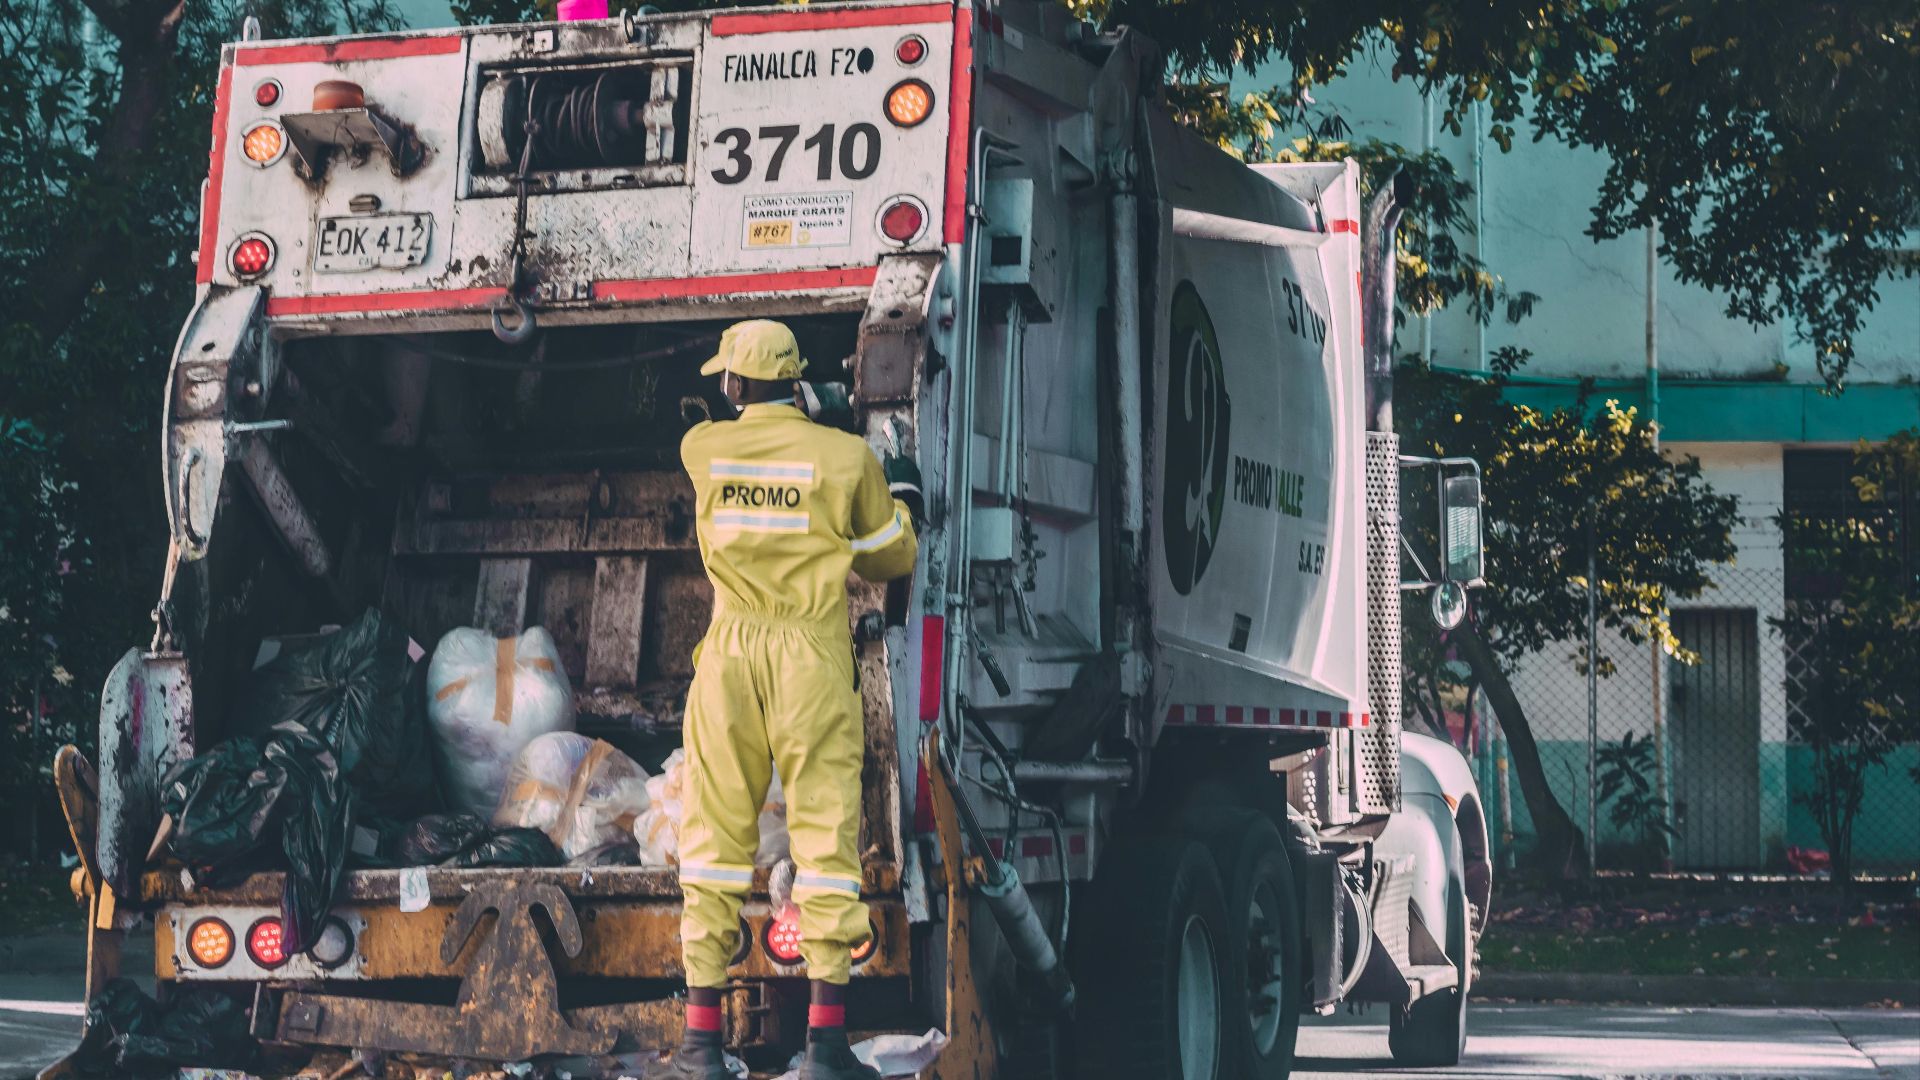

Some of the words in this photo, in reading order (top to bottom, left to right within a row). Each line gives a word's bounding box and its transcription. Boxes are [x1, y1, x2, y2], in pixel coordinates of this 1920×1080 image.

[724, 49, 817, 83] FANALCA
[711, 122, 881, 185] 3710
[748, 208, 798, 219] MARQUE
[802, 206, 845, 216] GRATIS
[319, 227, 369, 256] EOK
[376, 225, 424, 254] 412
[753, 223, 790, 239] #767
[722, 484, 801, 508] PROMO
[1234, 455, 1272, 510] PROMO
